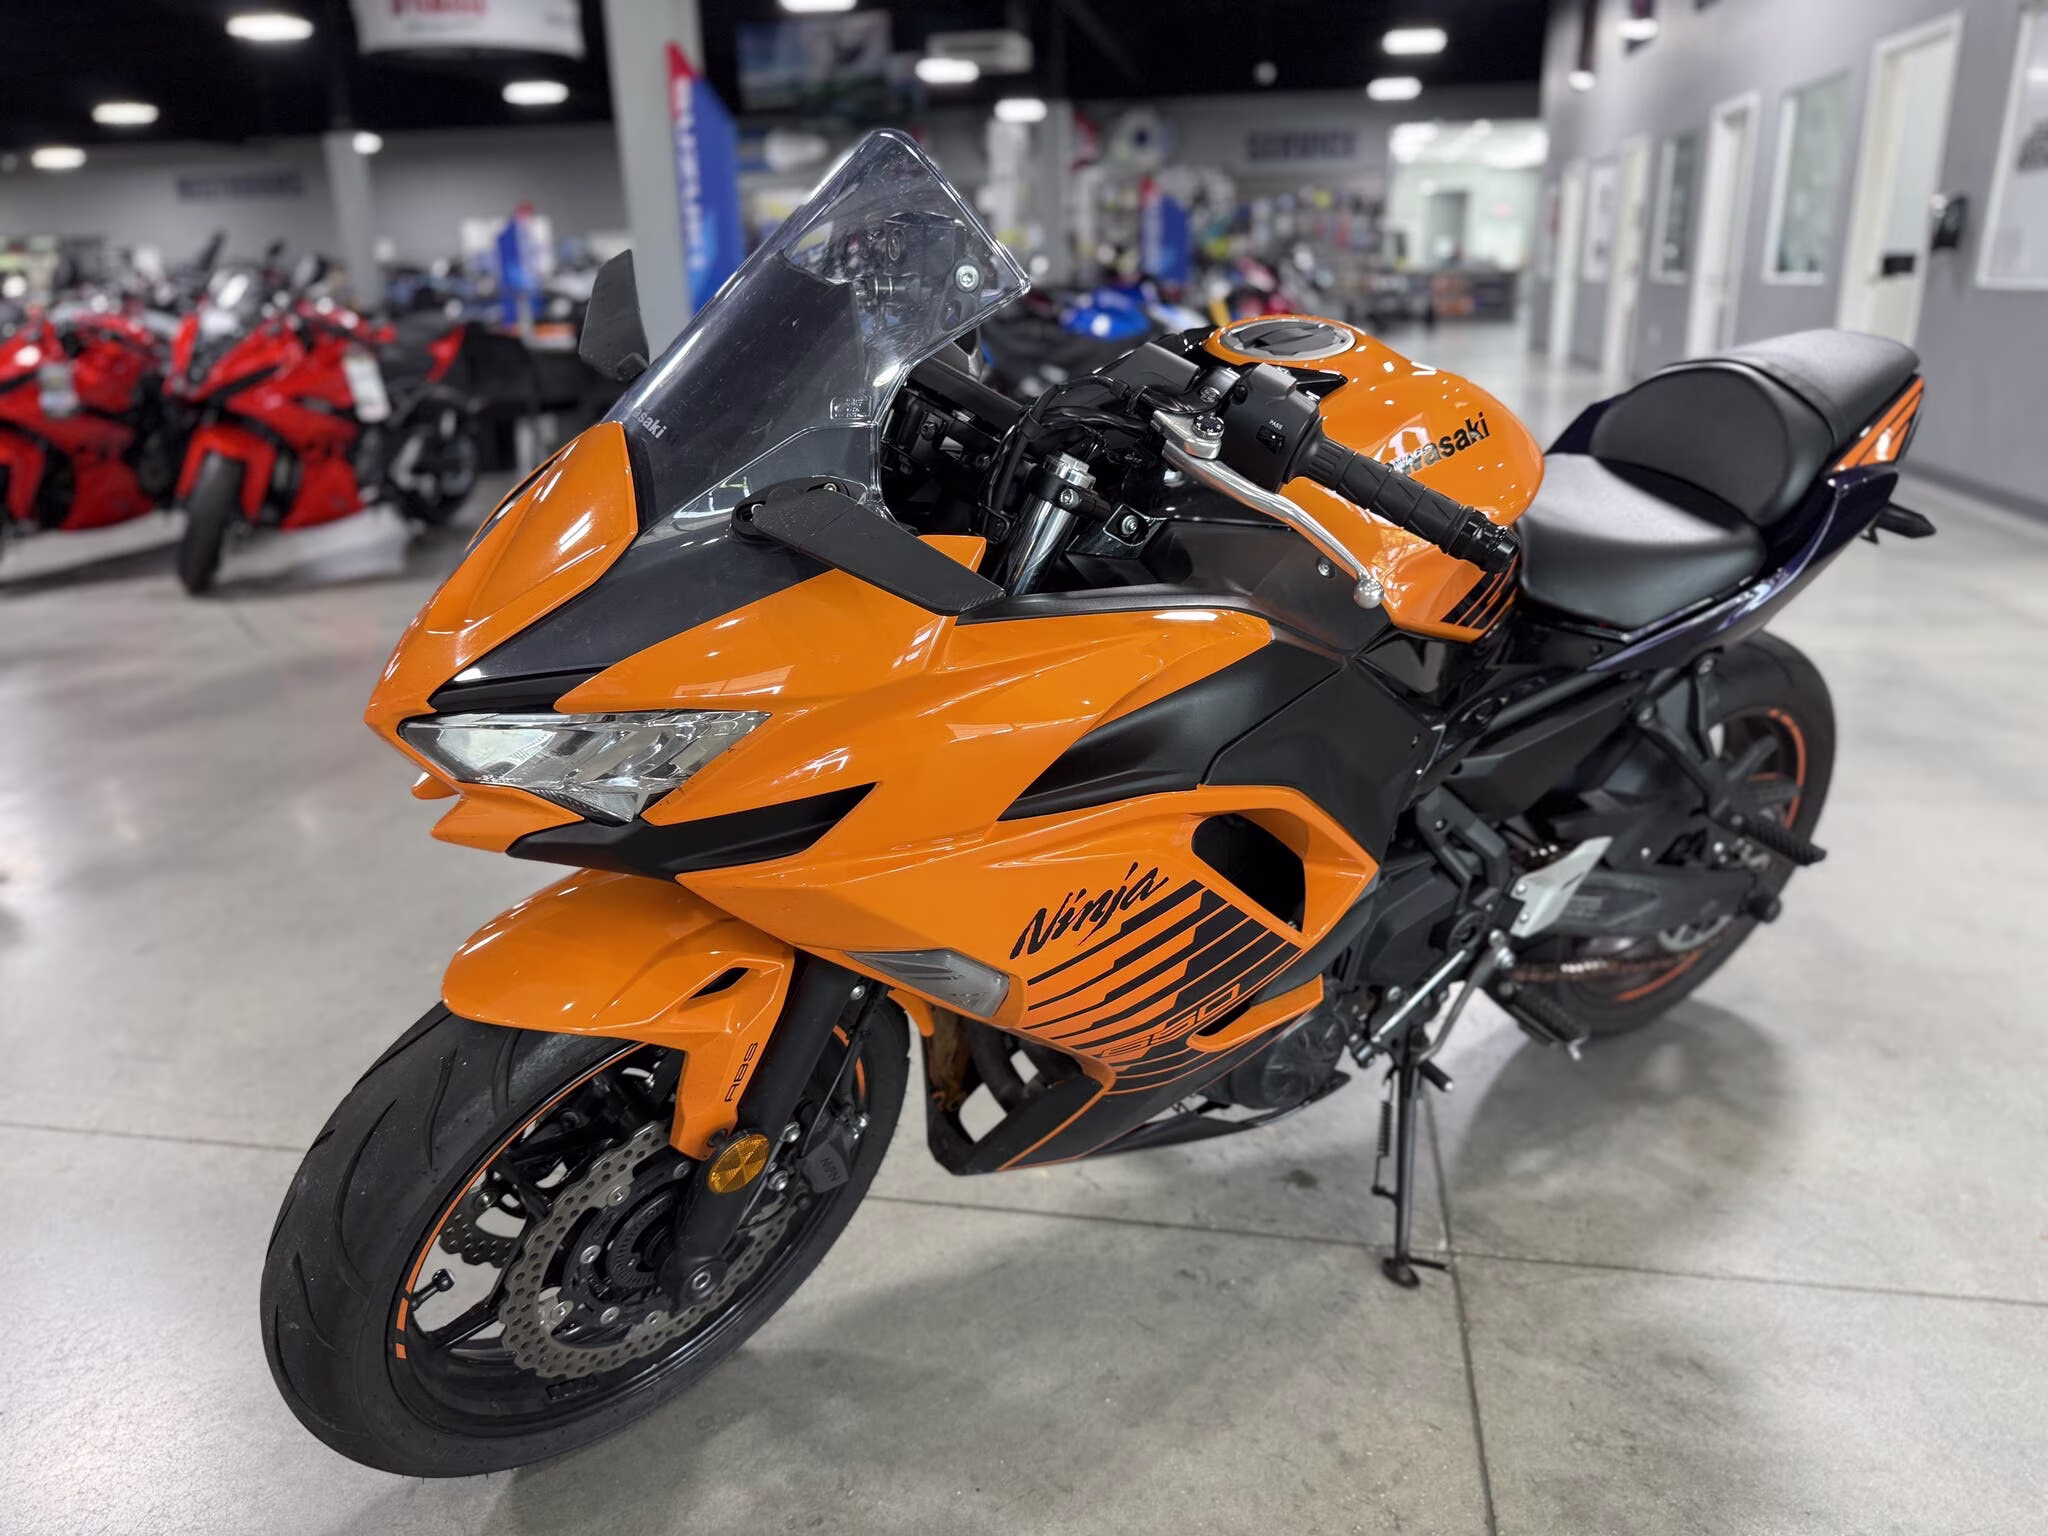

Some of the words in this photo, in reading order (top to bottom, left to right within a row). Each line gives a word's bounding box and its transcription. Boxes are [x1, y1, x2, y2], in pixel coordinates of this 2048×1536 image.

[1268, 419, 1283, 431] PASS
[1009, 861, 1170, 960] Ninja
[724, 1042, 758, 1103] ABS
